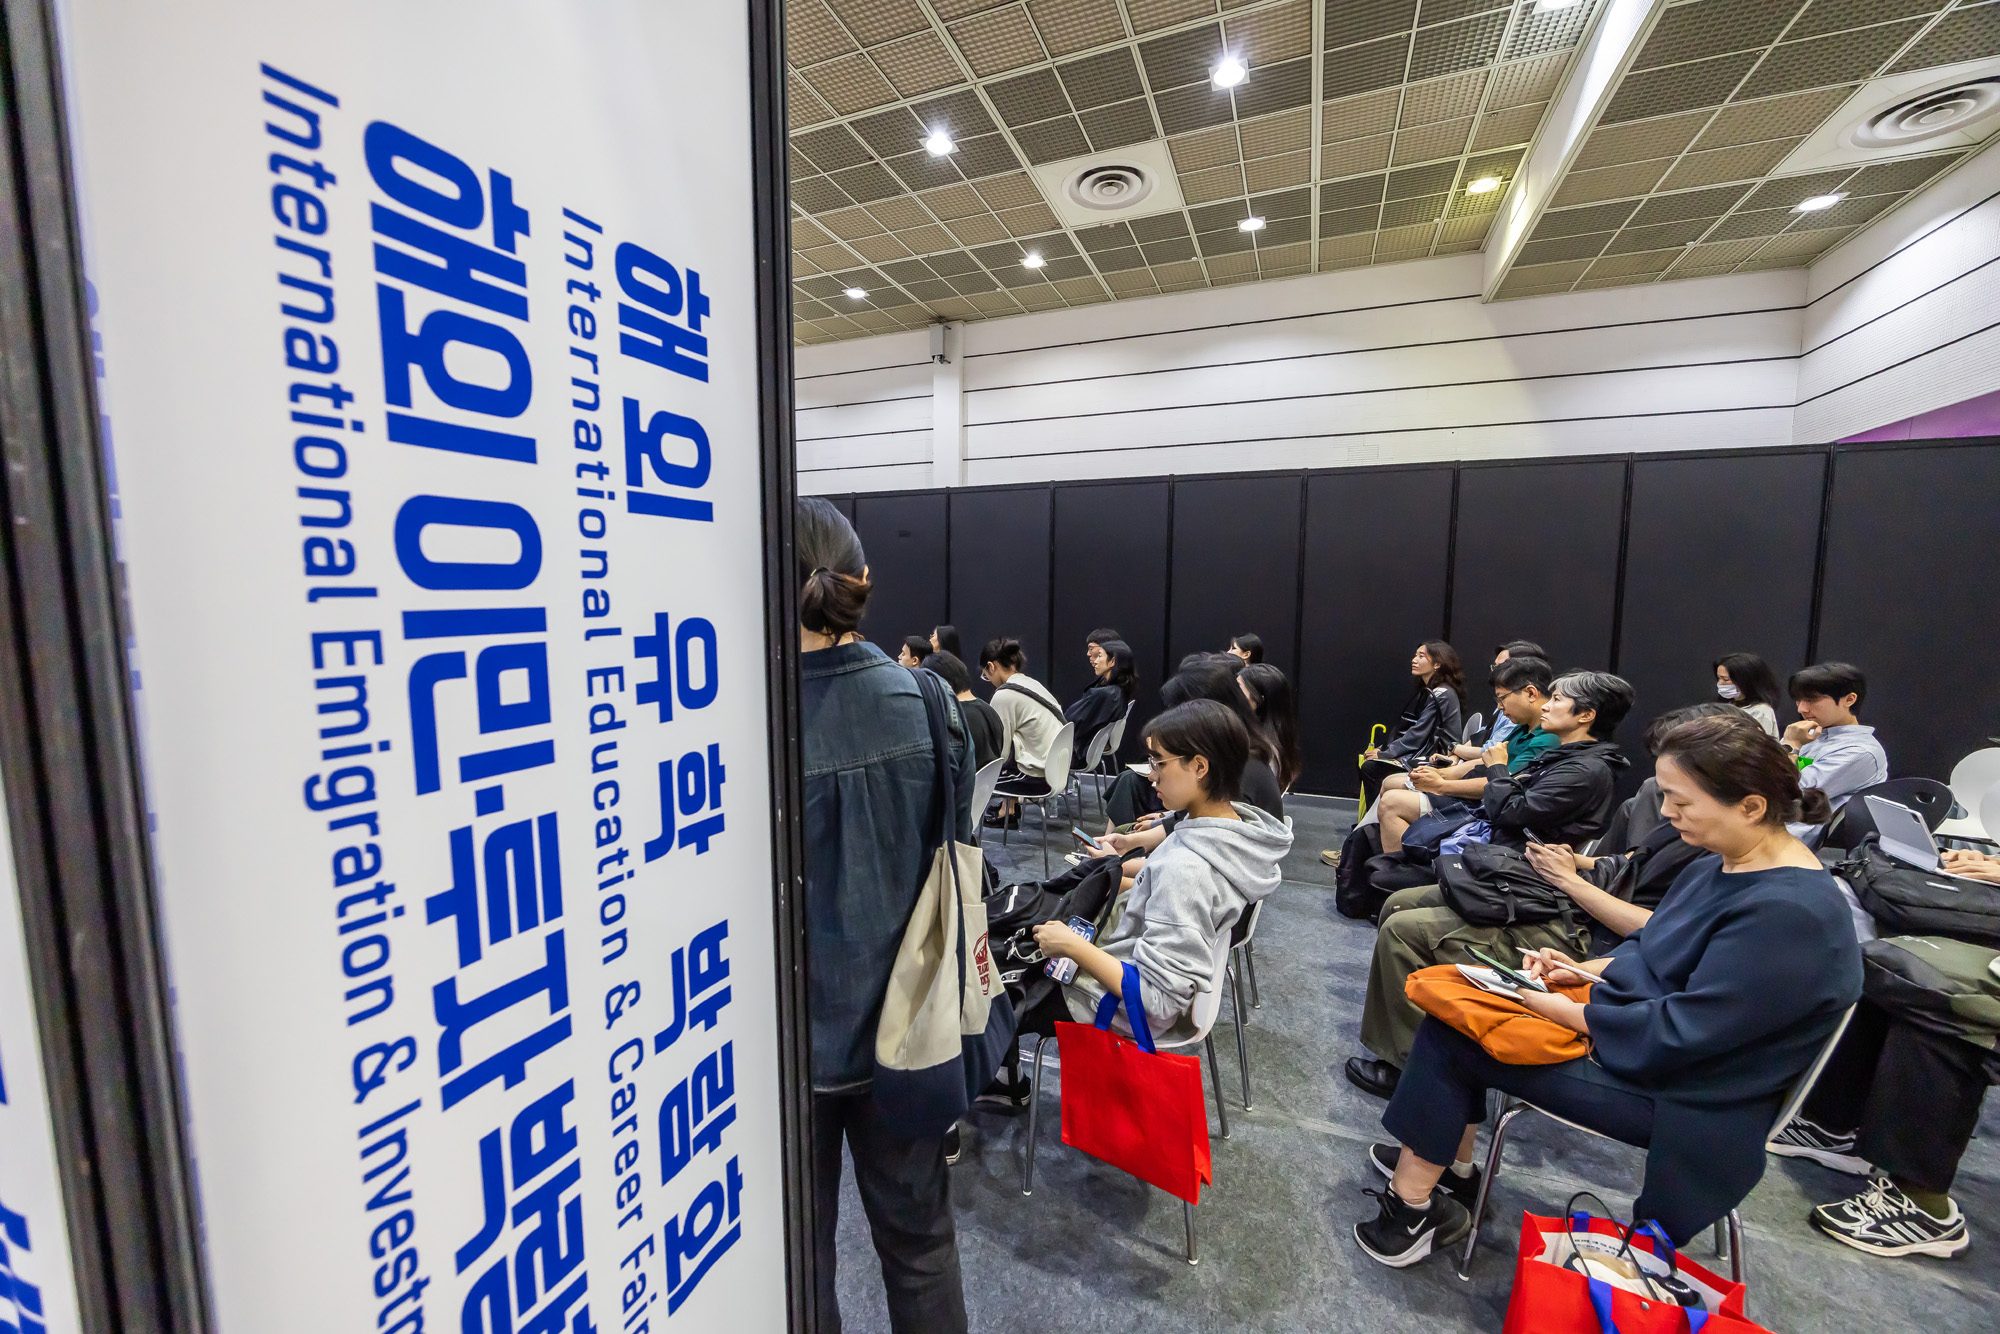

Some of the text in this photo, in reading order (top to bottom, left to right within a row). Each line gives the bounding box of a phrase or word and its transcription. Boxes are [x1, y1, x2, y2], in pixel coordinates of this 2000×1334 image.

[261, 64, 377, 602] International
[563, 208, 621, 640] International
[304, 630, 404, 1026] Emigration
[364, 121, 537, 464] 해외
[455, 1078, 600, 1334] 박람
[587, 666, 634, 964] Education
[615, 242, 740, 1316] 해외 유학 박람회
[353, 1036, 417, 1104] &
[605, 981, 640, 1029] &
[609, 1038, 643, 1228] Career
